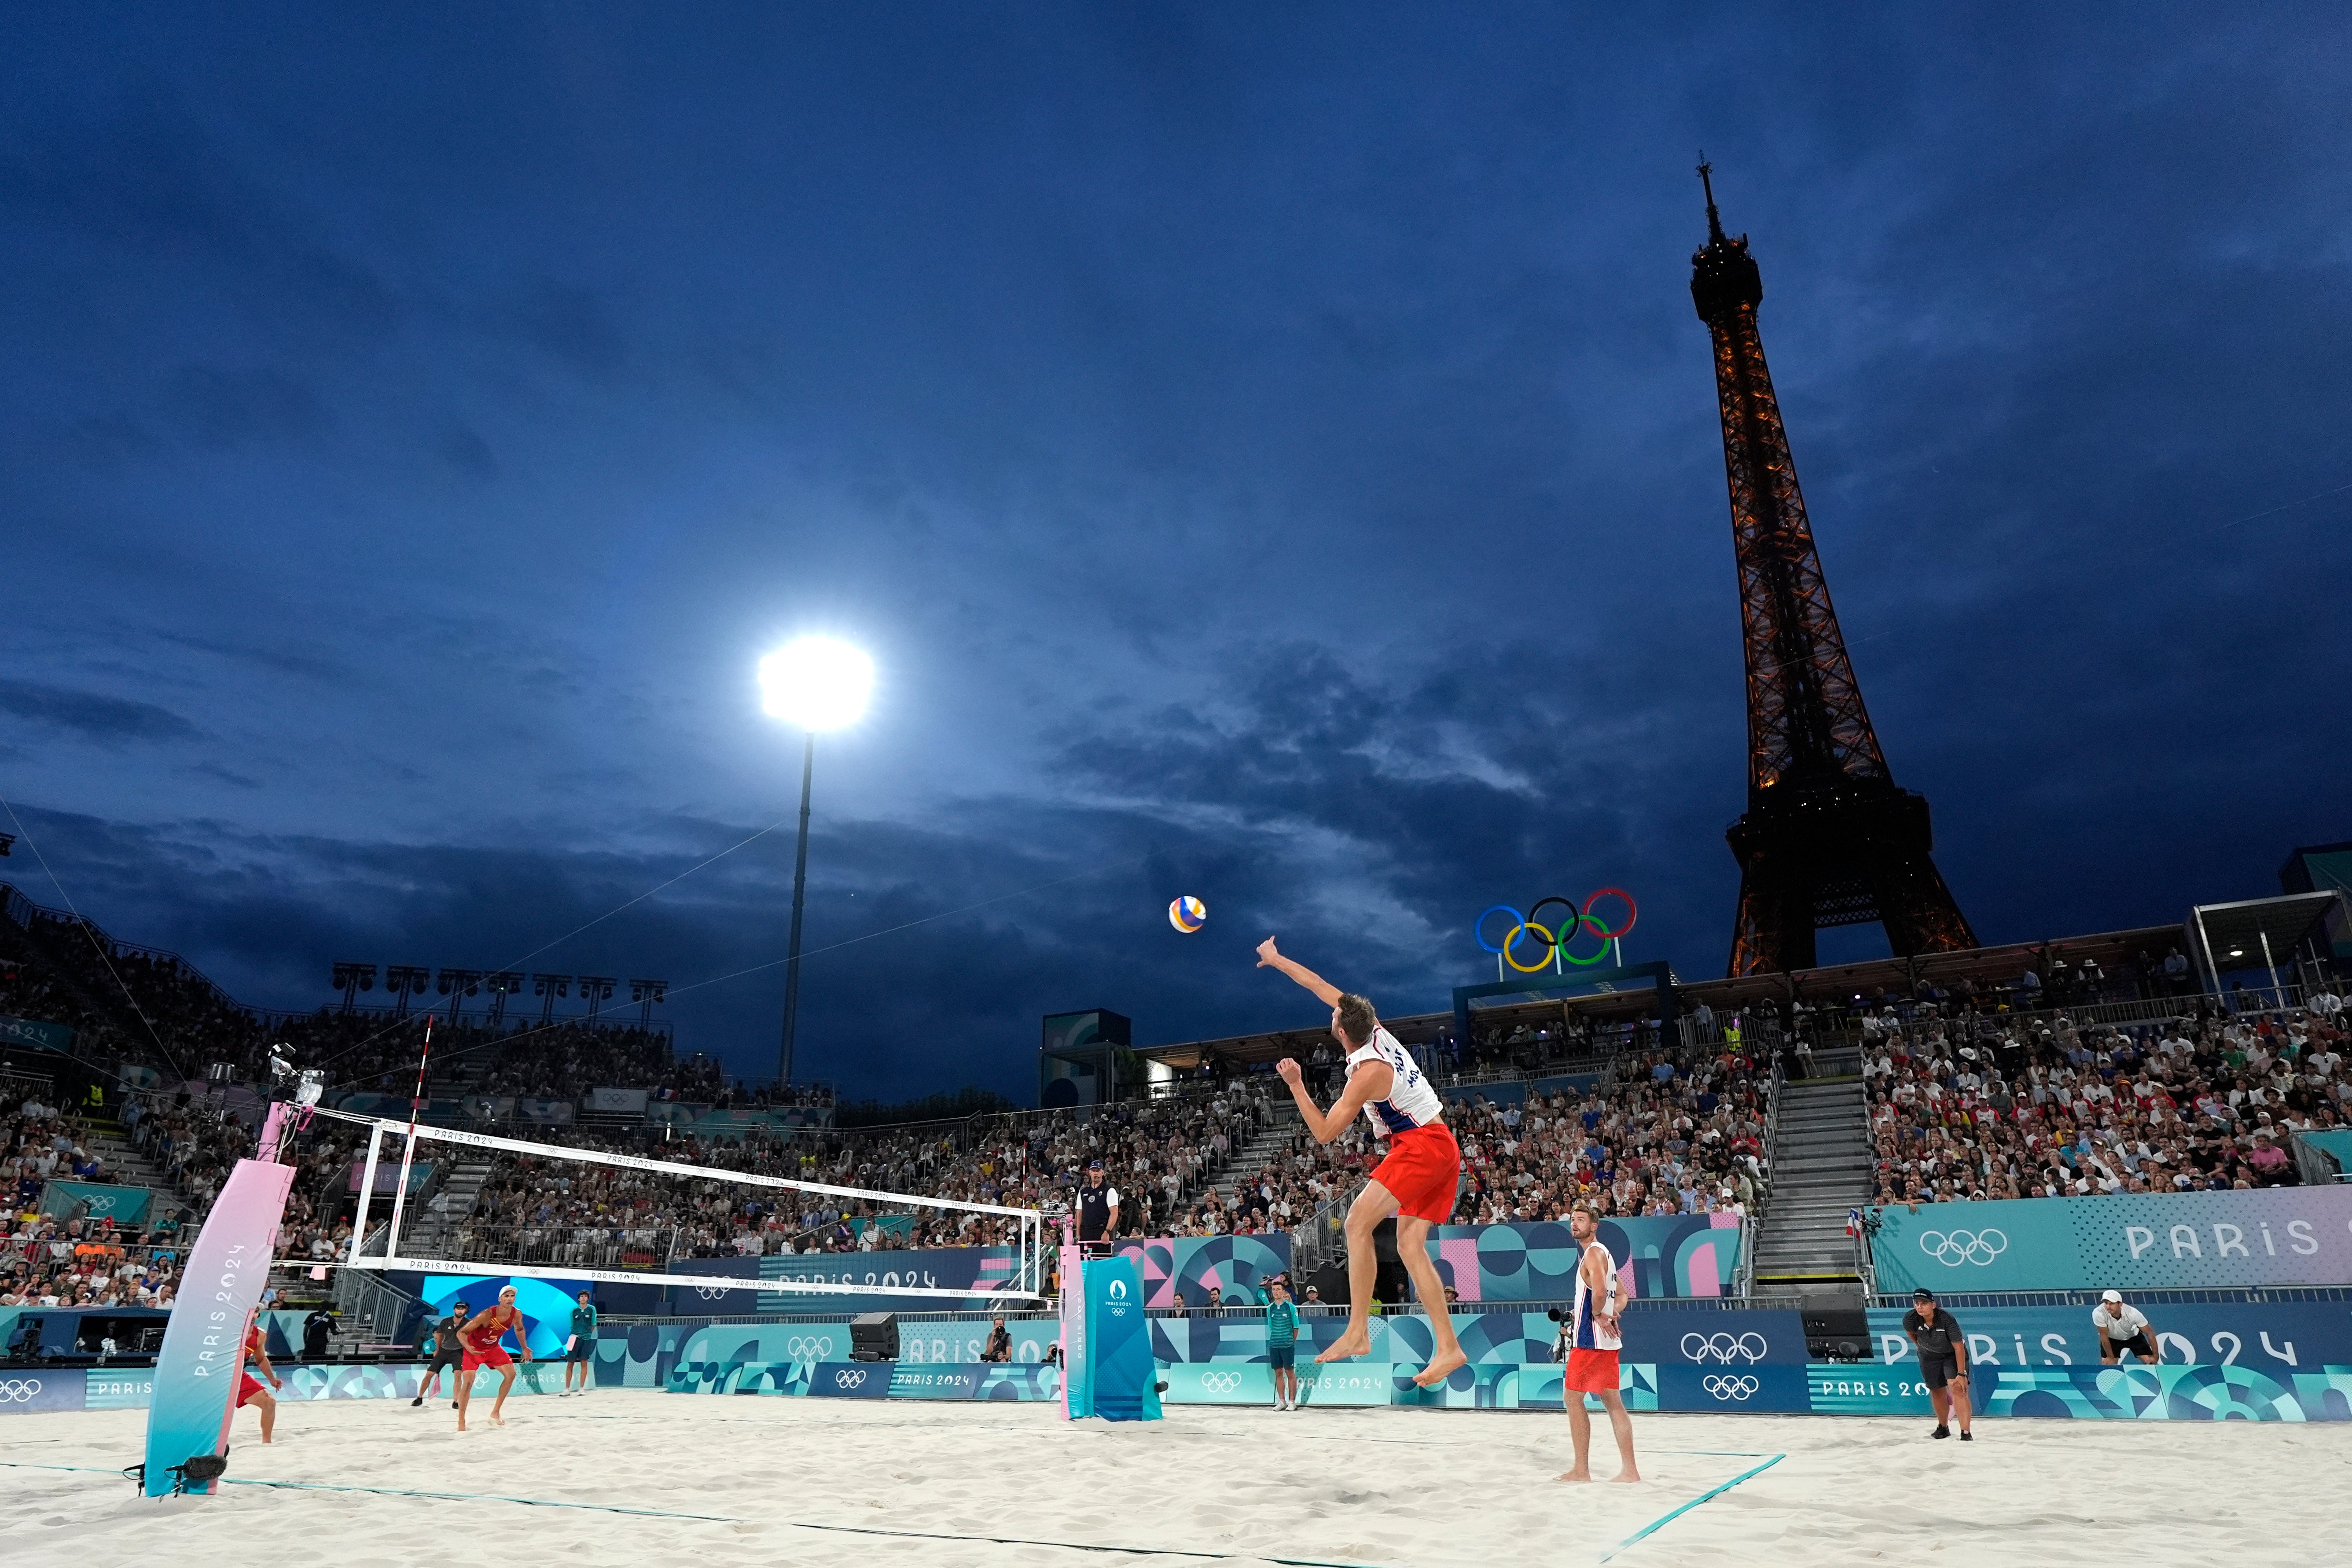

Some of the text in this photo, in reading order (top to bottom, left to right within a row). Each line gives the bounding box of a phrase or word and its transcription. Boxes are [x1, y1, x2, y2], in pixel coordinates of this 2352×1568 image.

[6, 1024, 48, 1041] 024
[467, 1135, 492, 1145] 2024
[633, 1159, 653, 1168] 2024
[355, 1173, 426, 1182] PRIS 224
[216, 1245, 245, 1302] 2024
[445, 1263, 471, 1272] 2024
[900, 1339, 981, 1363] ARiS
[1881, 1331, 2297, 1366] PRiS 024
[937, 1375, 969, 1385] 2024
[1296, 1377, 1382, 1389] ARiS 2024
[1899, 1382, 1930, 1396] 20
